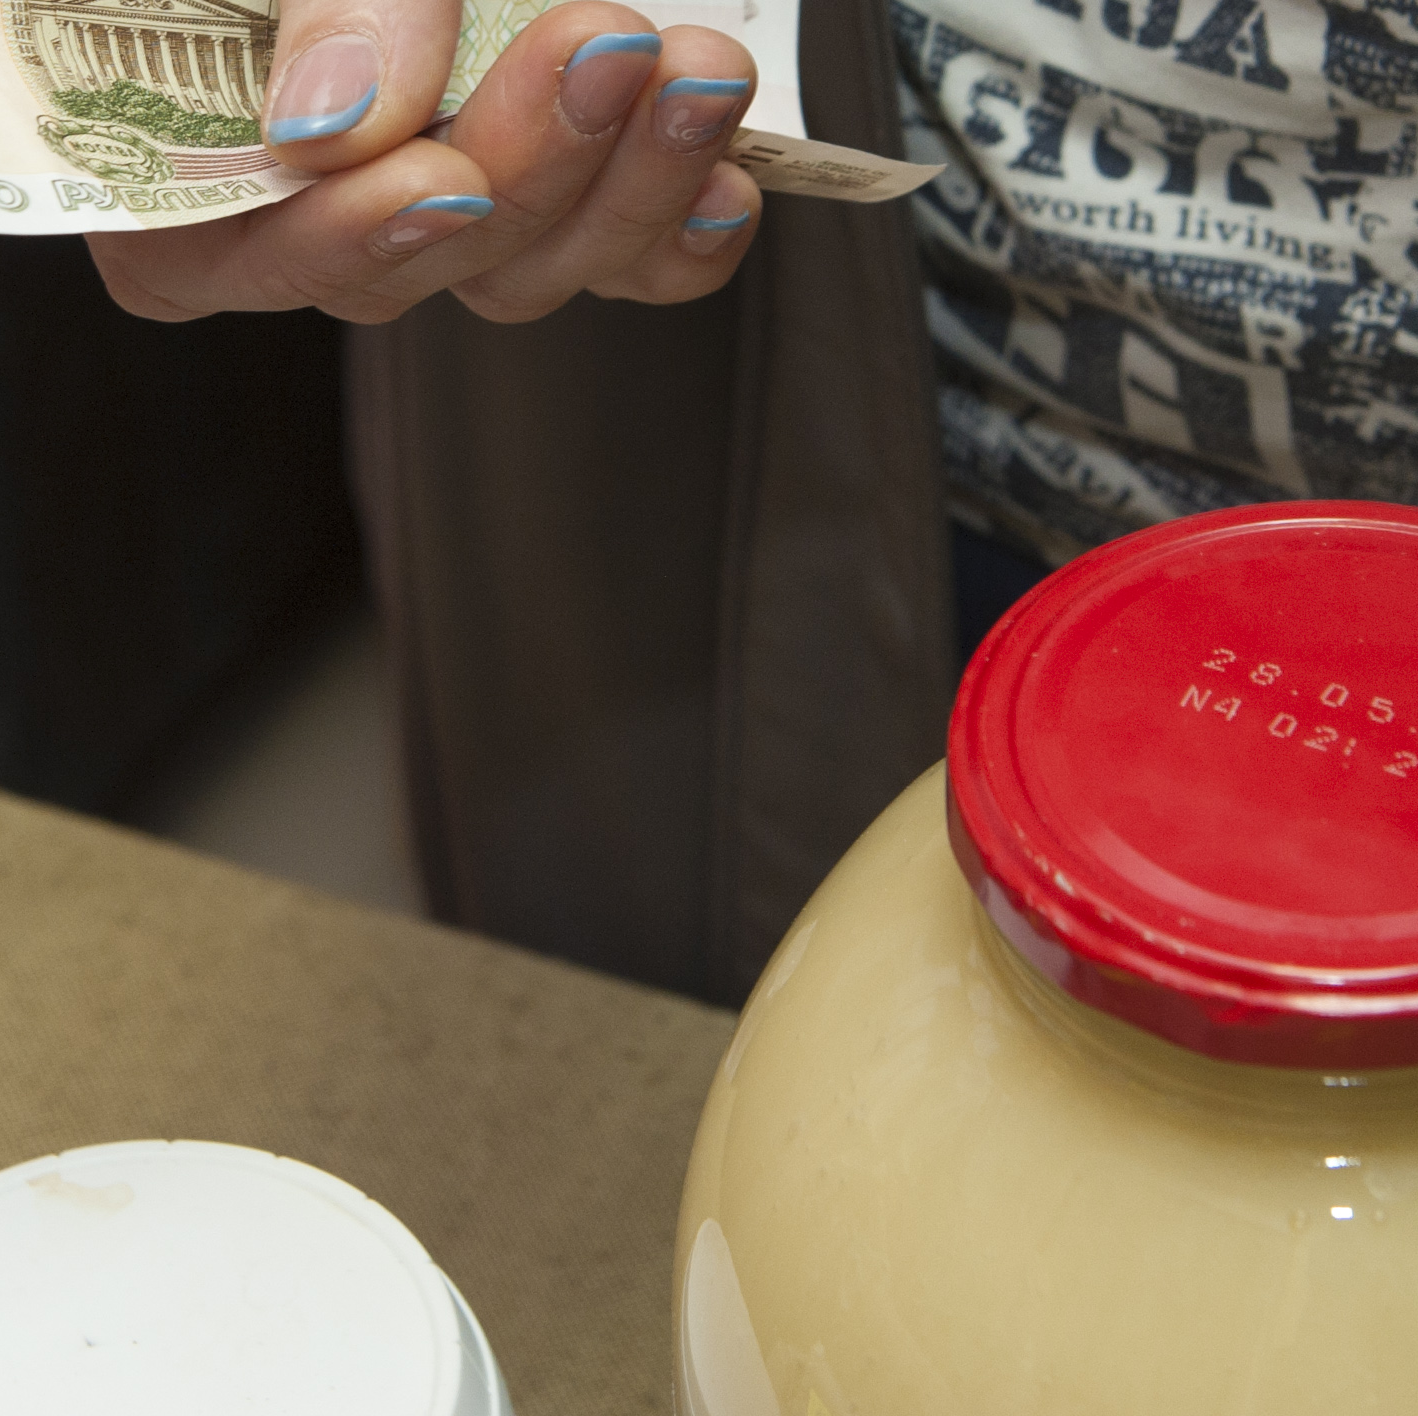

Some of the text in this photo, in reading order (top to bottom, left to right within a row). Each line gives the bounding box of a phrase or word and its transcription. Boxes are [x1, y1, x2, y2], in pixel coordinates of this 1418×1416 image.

[51, 176, 269, 214] РУБЛЕЙ
[1011, 186, 1349, 272] worth living.
[1179, 684, 1242, 722] N4
